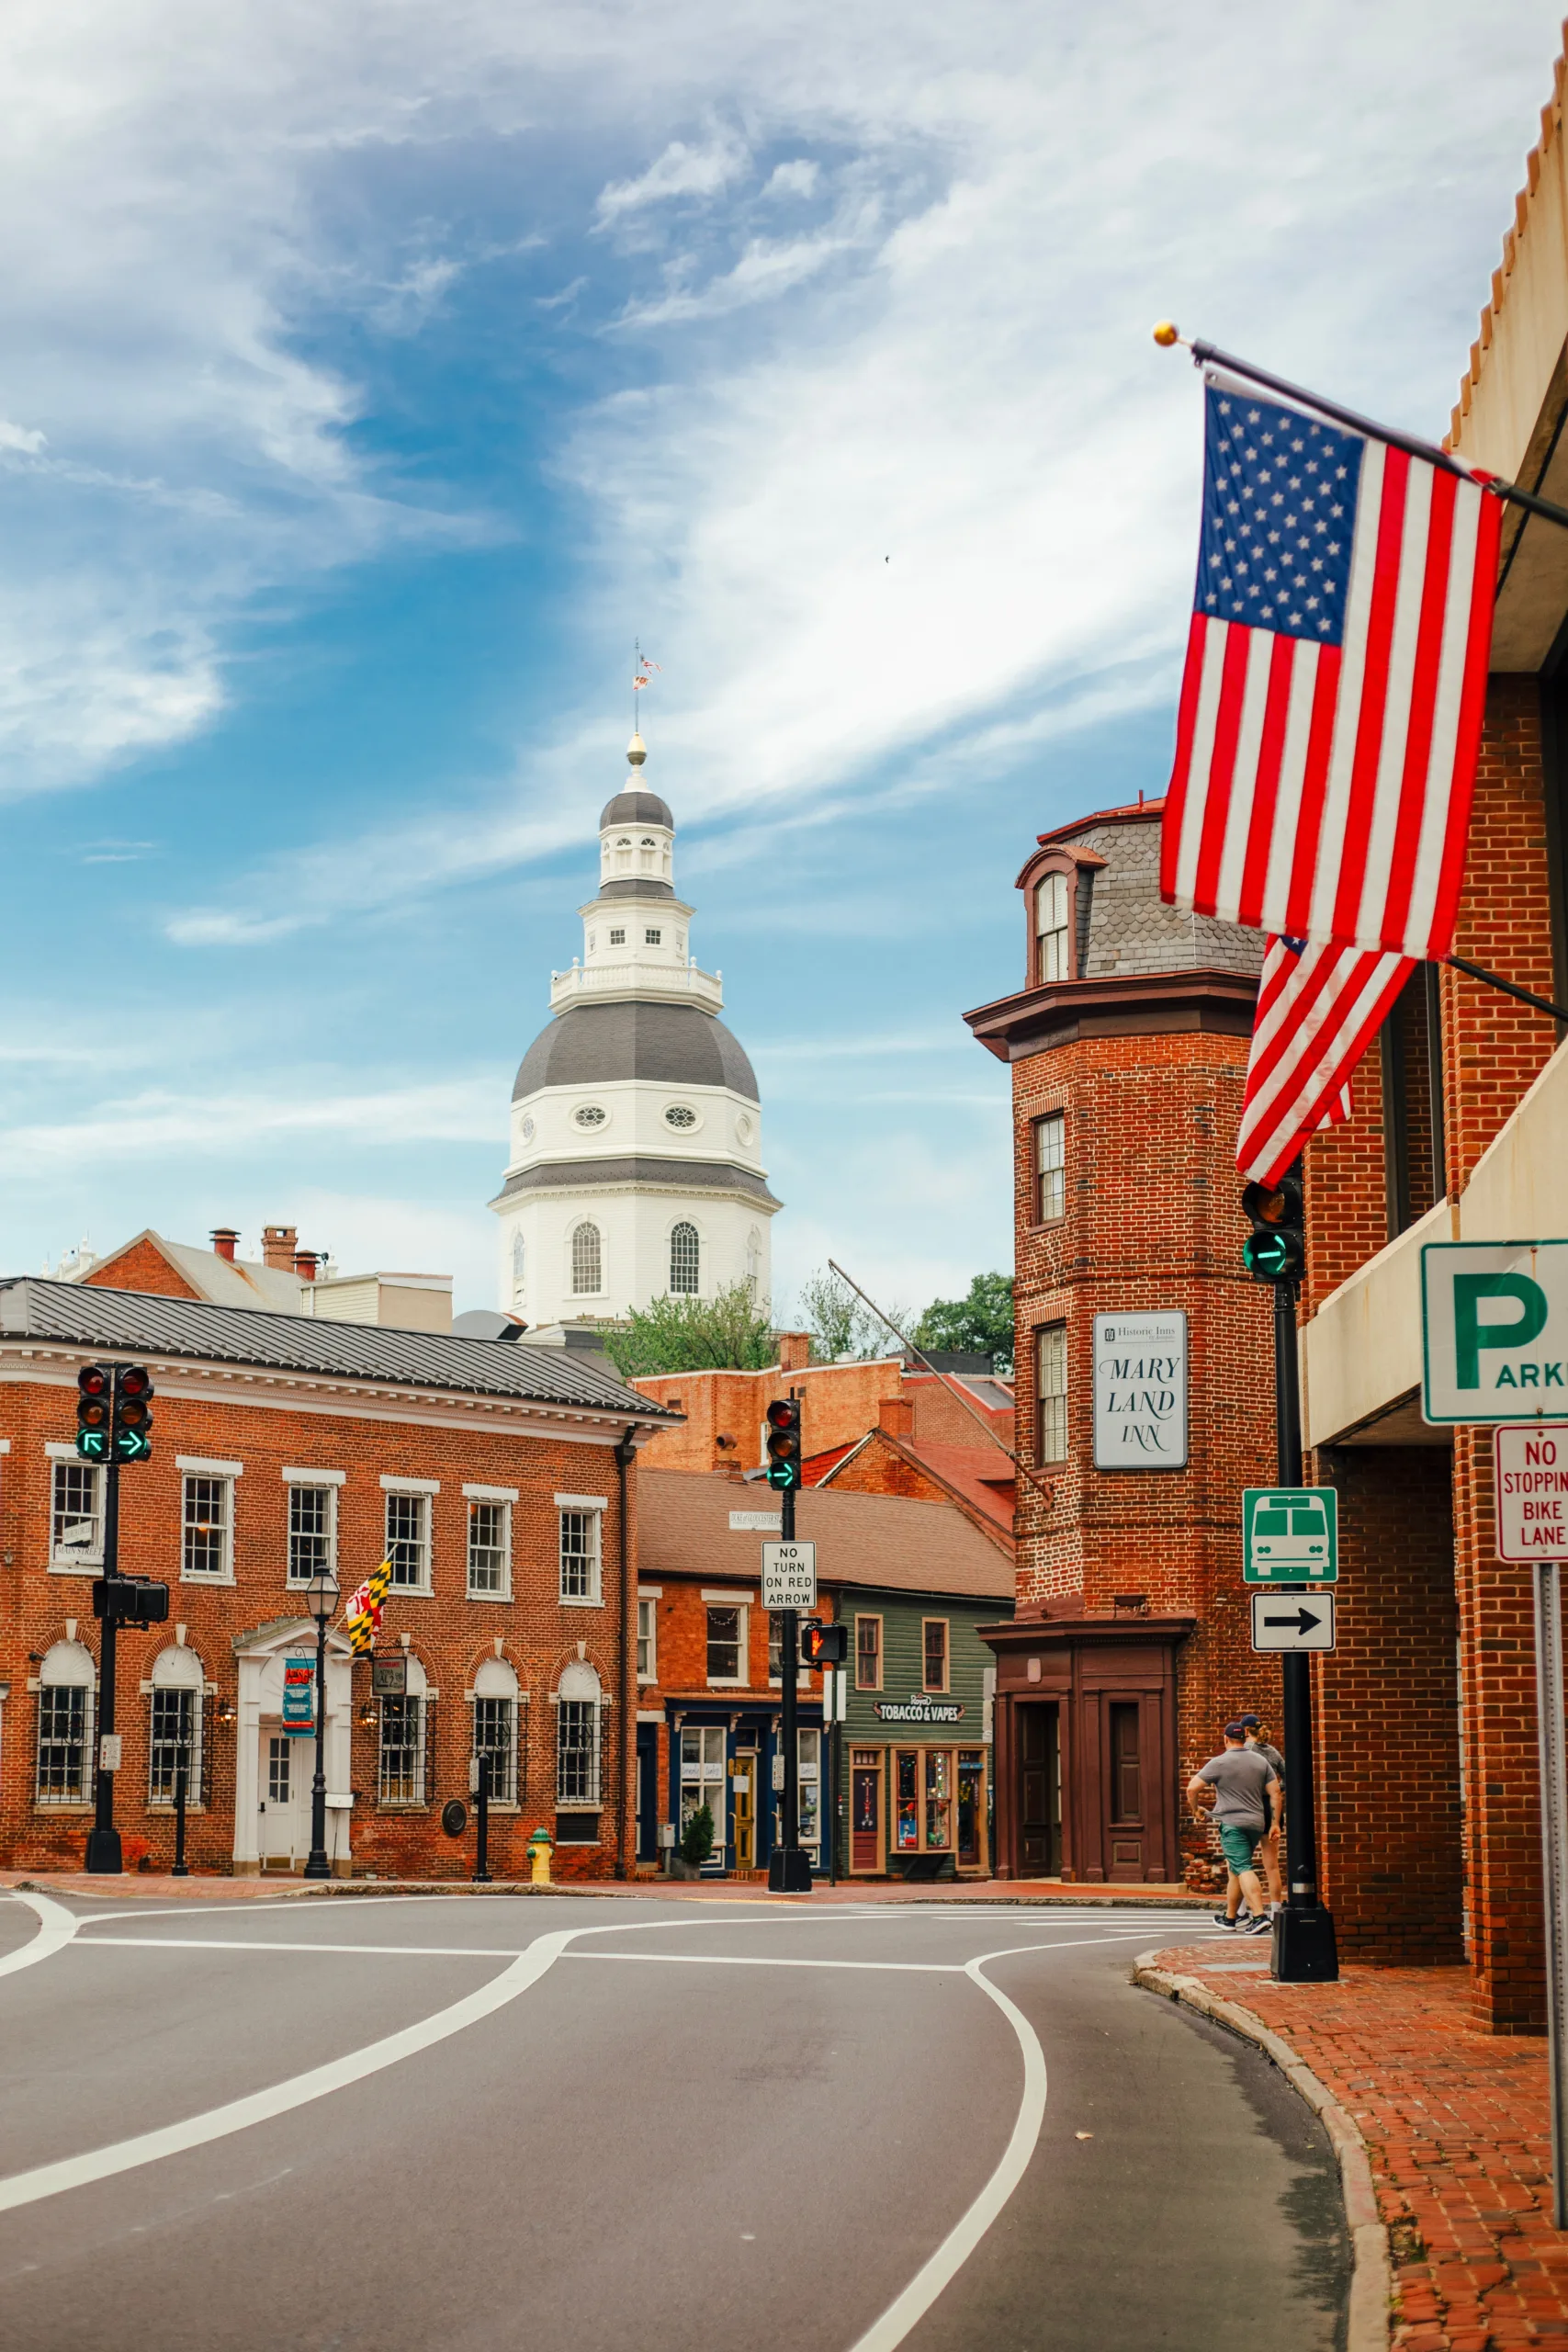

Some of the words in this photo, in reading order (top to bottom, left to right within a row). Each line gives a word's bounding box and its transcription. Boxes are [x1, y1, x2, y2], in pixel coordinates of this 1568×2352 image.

[1118, 1327, 1154, 1337] Historic
[1156, 1326, 1176, 1336] Inns
[1453, 1272, 1568, 1390] PARK
[1099, 1357, 1181, 1385] MARY
[1106, 1390, 1175, 1420] LAND
[1122, 1424, 1170, 1452] INN
[1525, 1441, 1557, 1465] NO
[1523, 1500, 1563, 1521] BIKE
[1521, 1526, 1567, 1546] LANE
[57, 1545, 75, 1554] MAIN
[77, 1547, 103, 1555] STREET
[780, 1548, 797, 1557] NO
[773, 1563, 805, 1572] TURN
[766, 1577, 782, 1588] ON
[788, 1577, 812, 1588] RED
[768, 1594, 810, 1603] ARROW
[880, 1705, 923, 1721] TOBACCO
[923, 1708, 931, 1722] &
[931, 1707, 958, 1722] VAPES
